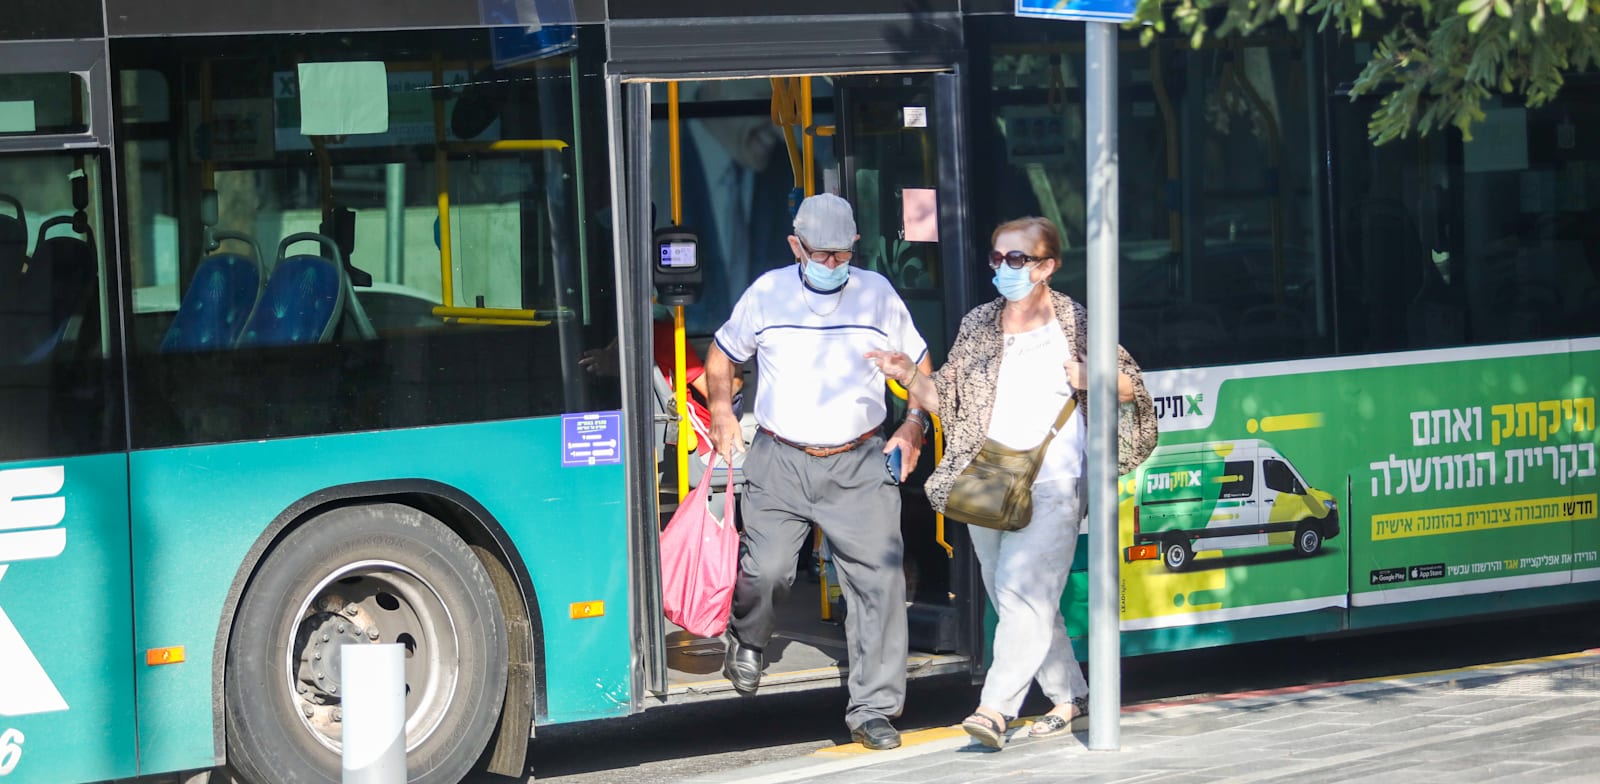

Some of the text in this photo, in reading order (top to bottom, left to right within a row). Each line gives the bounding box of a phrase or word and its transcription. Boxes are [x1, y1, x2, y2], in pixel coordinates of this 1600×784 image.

[1410, 397, 1595, 446] תיקתק ואתם
[1370, 442, 1596, 497] בקריית הממשלה
[1376, 500, 1593, 536] חדש! תחבורה ציבורית בהזמנה אישית
[1561, 554, 1573, 564] את
[1574, 551, 1597, 562] הורידו
